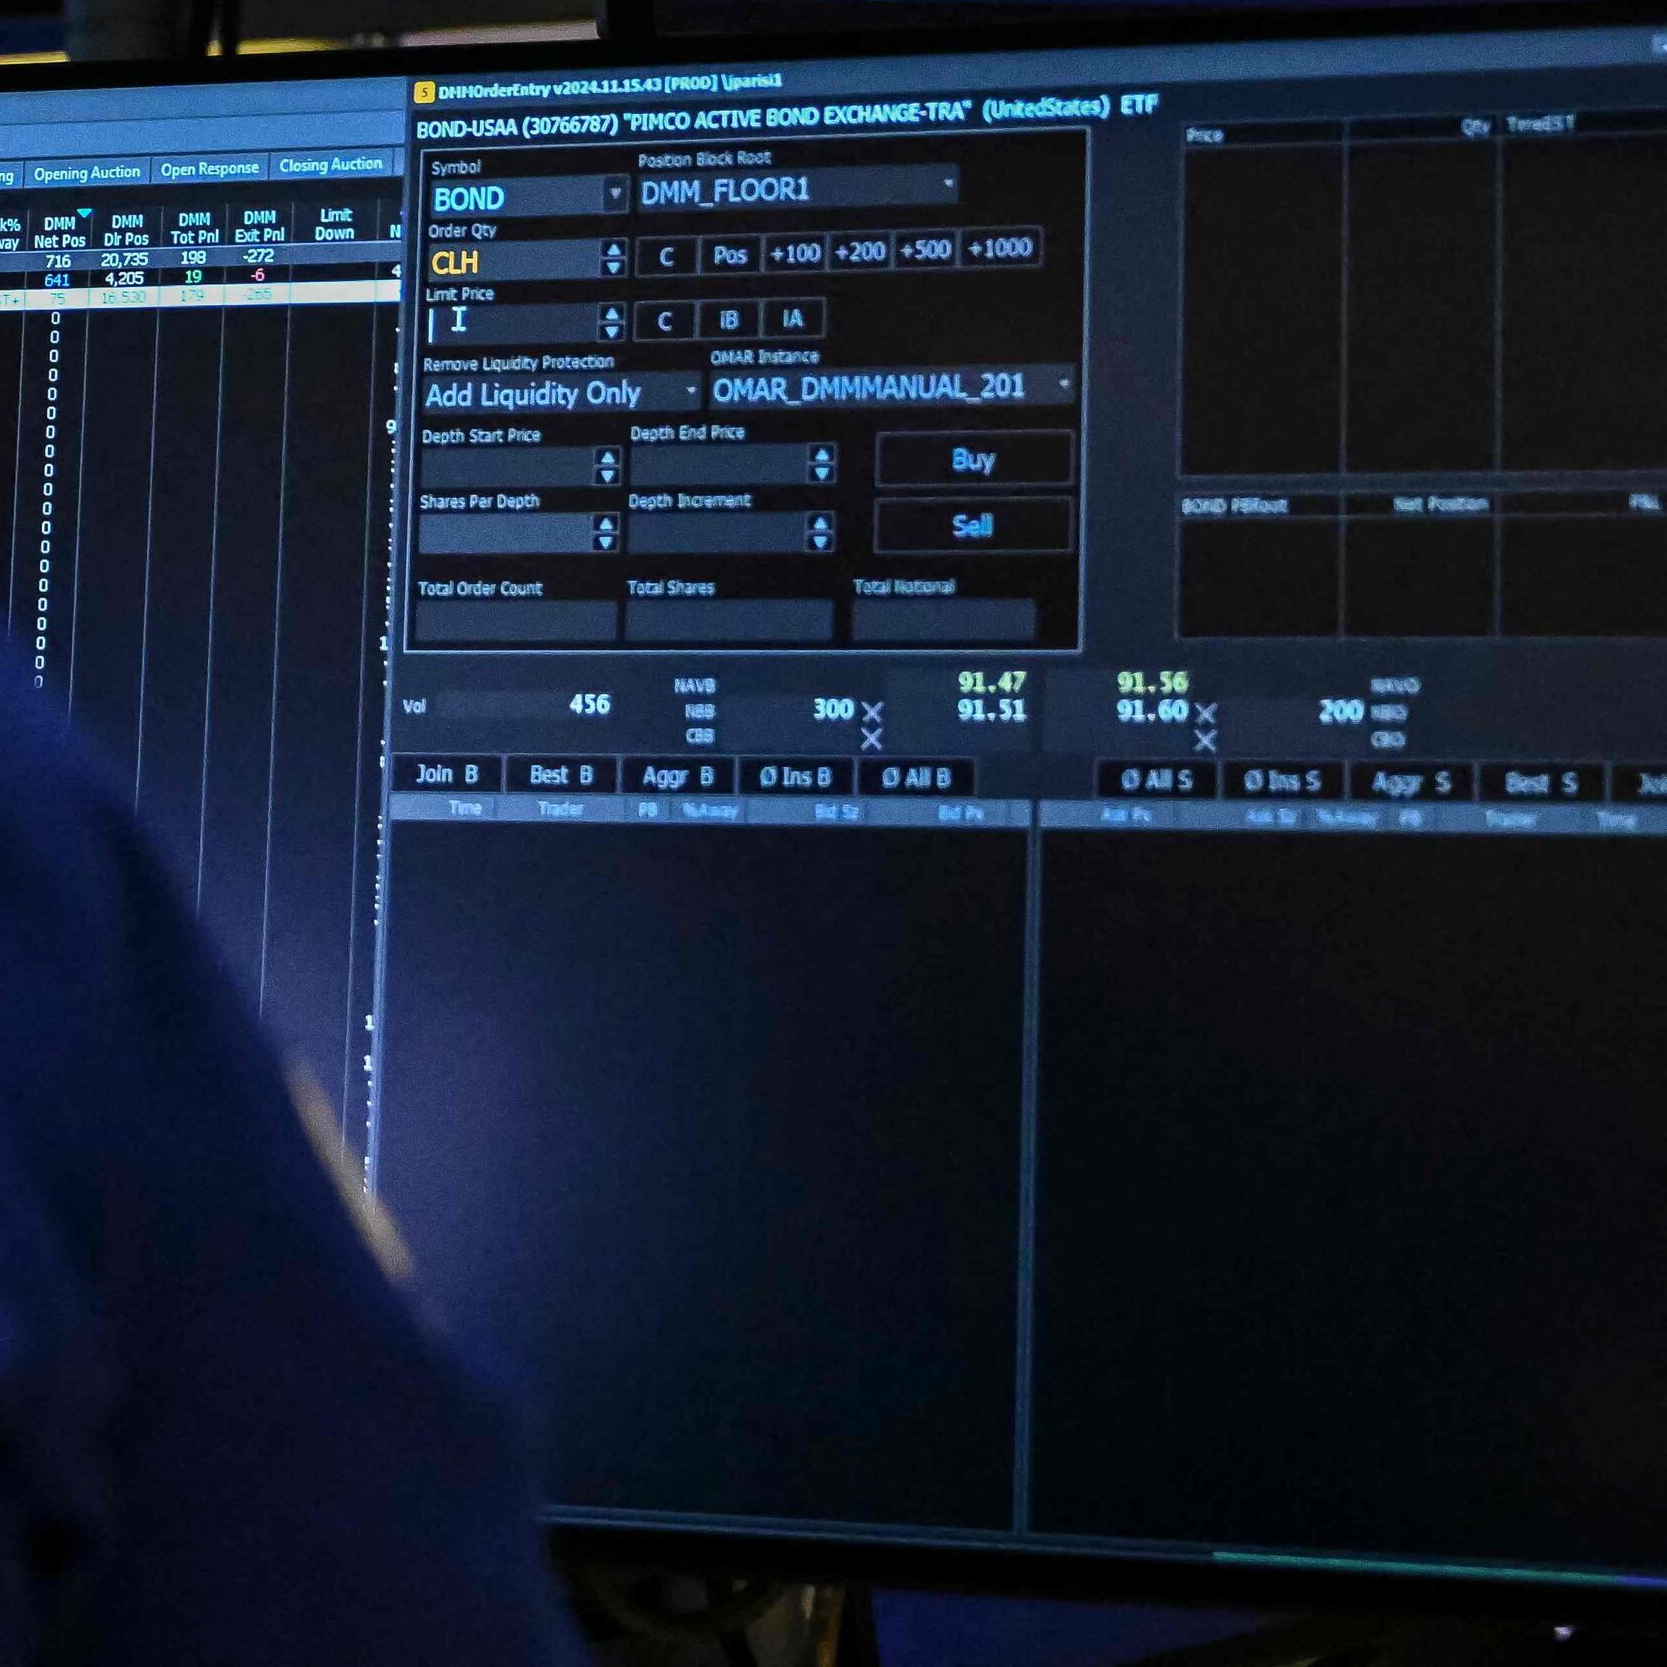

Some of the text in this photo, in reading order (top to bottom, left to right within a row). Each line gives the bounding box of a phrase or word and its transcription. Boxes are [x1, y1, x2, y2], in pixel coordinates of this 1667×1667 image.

[438, 75, 716, 99] DMMOrderEntry [PROD]
[417, 119, 518, 138] BOND-USAA
[523, 114, 618, 135] (30766787)
[695, 110, 761, 129] ACTIVE
[766, 108, 819, 126] BOND
[1121, 94, 1159, 115] ETF
[34, 166, 140, 183] Opening Auction
[161, 161, 259, 179] Open Response
[280, 157, 383, 175] Closing Auction
[431, 160, 481, 176] Symbol
[434, 186, 505, 211] BOND
[641, 176, 810, 209] DMM_FLOOR1
[429, 224, 496, 239] Order Qty
[46, 249, 274, 268] 716 198 -272
[101, 252, 149, 267] 20,735
[432, 250, 479, 276] CLH
[715, 245, 748, 265] Pos
[462, 287, 494, 301] Price
[426, 380, 641, 409] Add Liquidity Only
[713, 372, 1025, 404] OMAR_DMMMANUAL_201
[952, 448, 996, 476] Buy
[953, 514, 994, 537] Sell
[958, 671, 1027, 694] 91.47
[403, 694, 855, 720] Vol 456 300
[958, 699, 1027, 722] 91.51
[1117, 699, 1189, 724] 91.60
[1319, 699, 1365, 724] 200
[416, 764, 453, 784] Join
[530, 765, 568, 784] Best
[643, 767, 689, 789] Aggr
